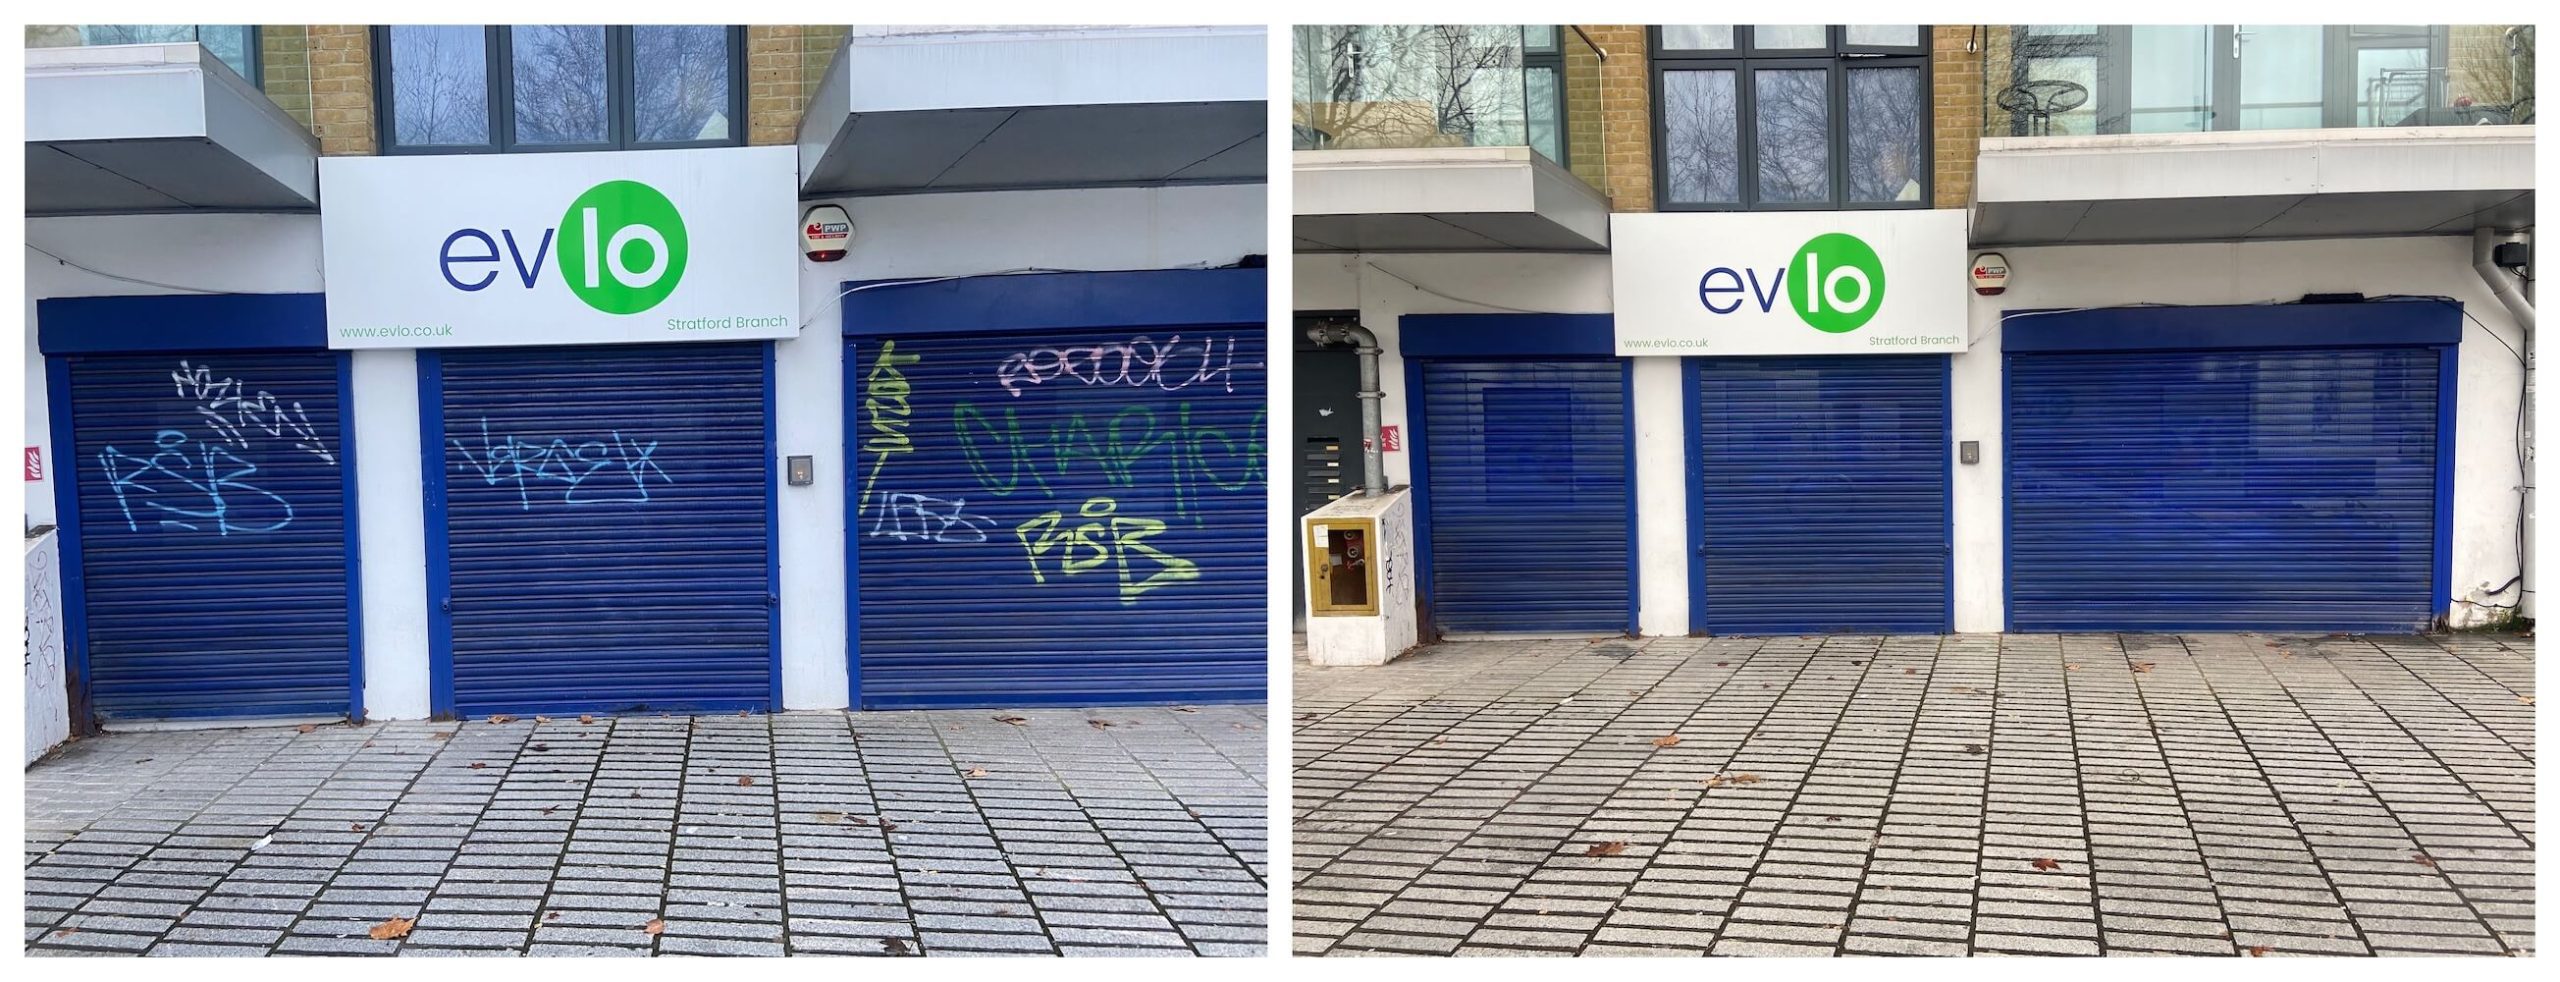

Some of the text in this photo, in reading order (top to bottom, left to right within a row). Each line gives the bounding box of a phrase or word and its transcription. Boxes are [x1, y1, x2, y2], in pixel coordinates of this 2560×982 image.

[824, 224, 847, 233] PWP
[438, 206, 669, 293] evlo
[1698, 252, 1872, 315] evlo
[666, 313, 789, 331] Stratford Branch
[339, 323, 453, 338] www.evlo.co.uk
[1623, 336, 1709, 349] www.evlo.co.uk
[1868, 334, 1960, 346] Stratford Branch
